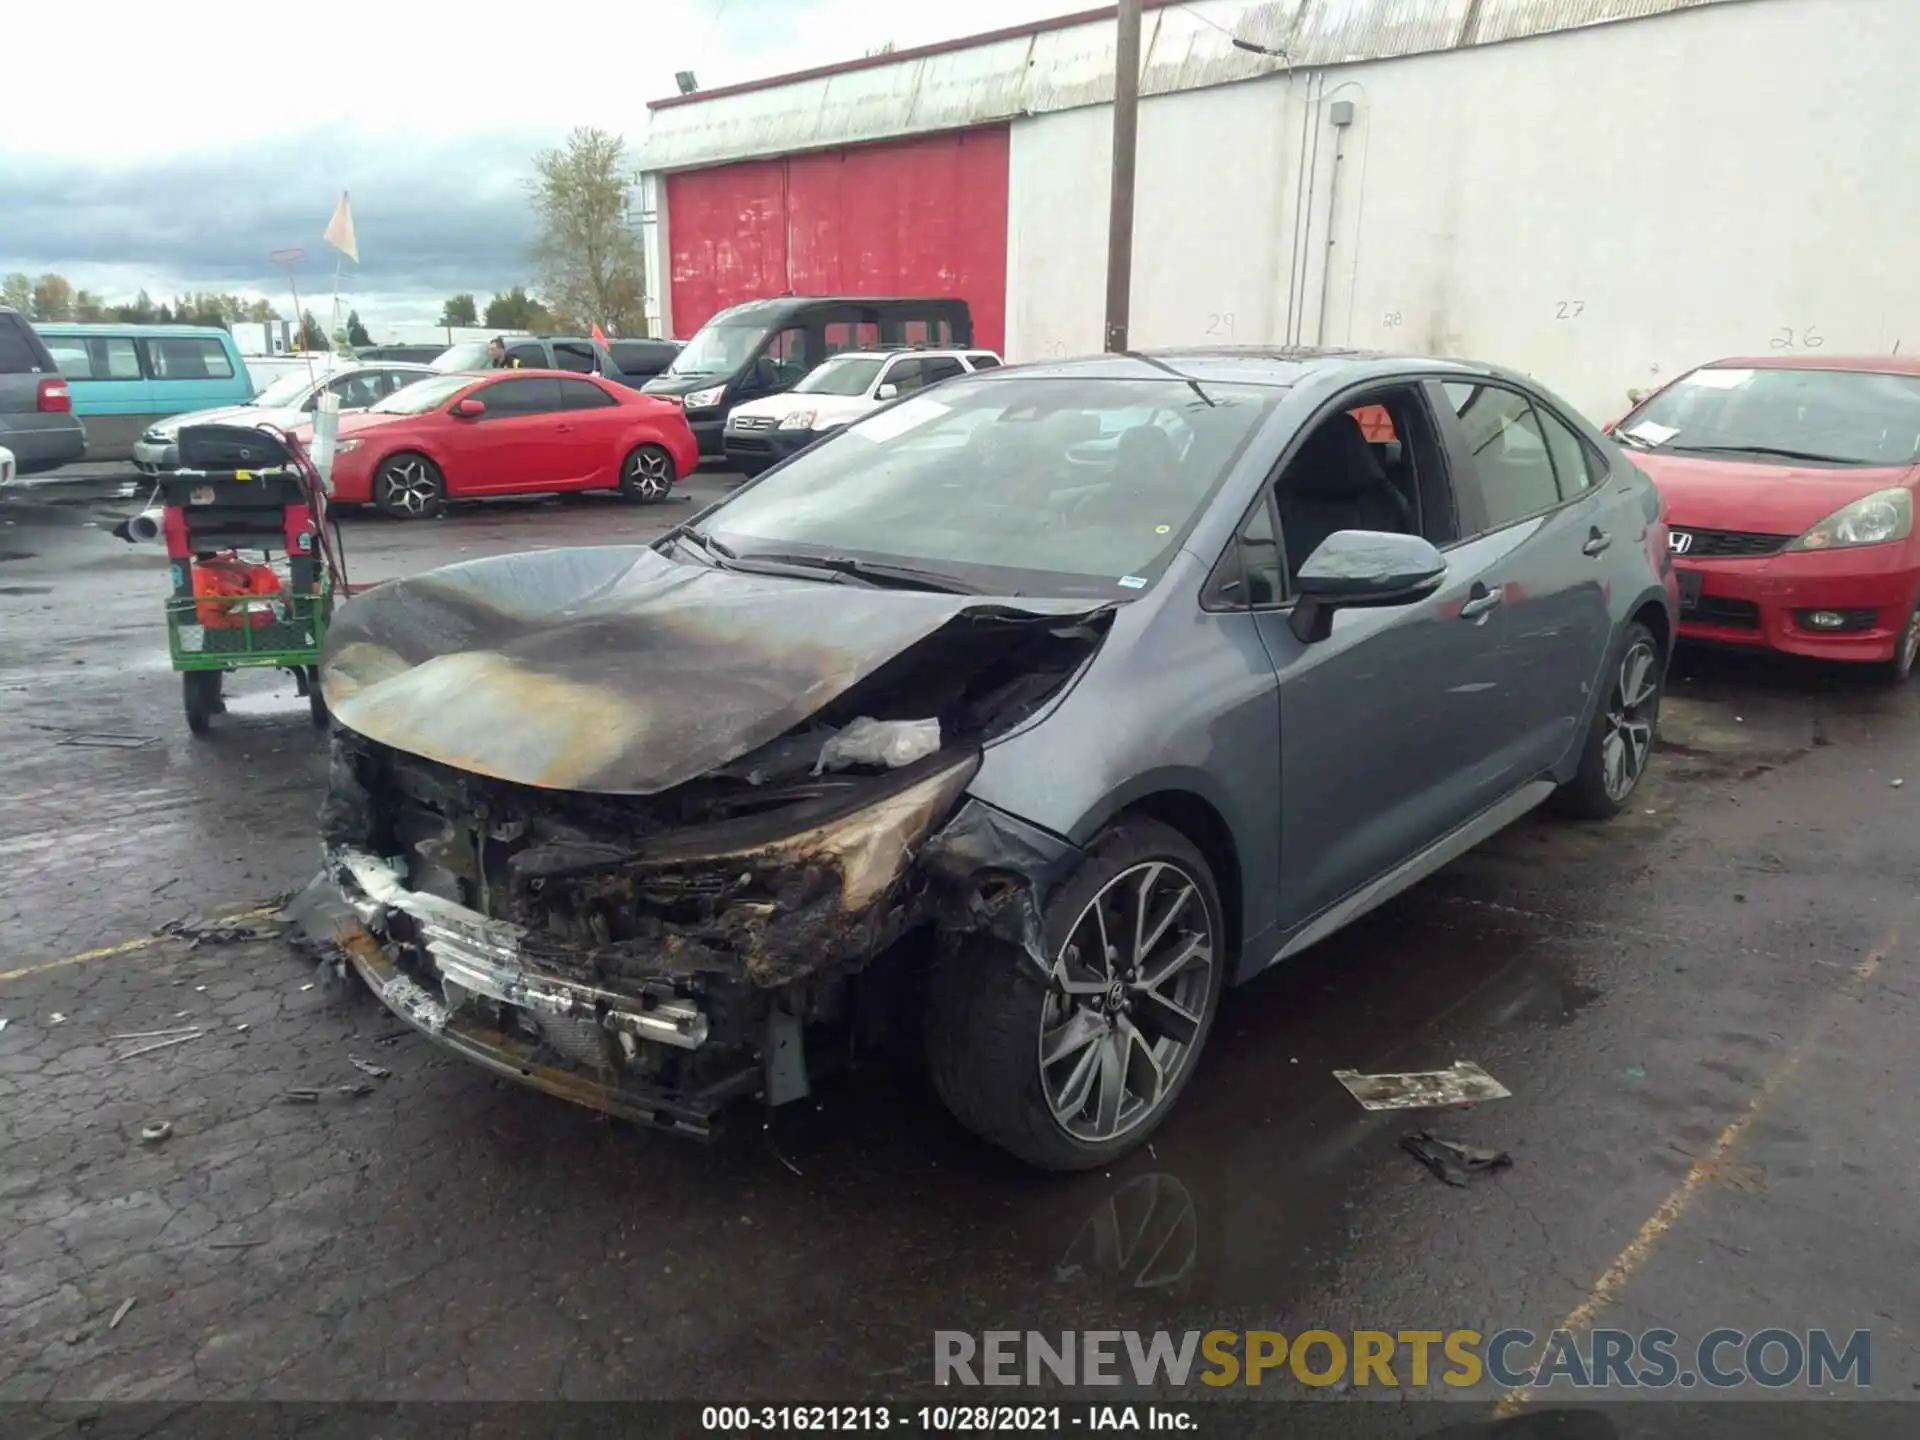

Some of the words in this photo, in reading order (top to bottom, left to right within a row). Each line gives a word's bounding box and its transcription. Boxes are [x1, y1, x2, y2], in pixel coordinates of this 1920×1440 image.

[1382, 311, 1402, 329] 28
[1556, 300, 1585, 320] 27
[1204, 312, 1236, 339] 29
[1769, 325, 1824, 349] 26
